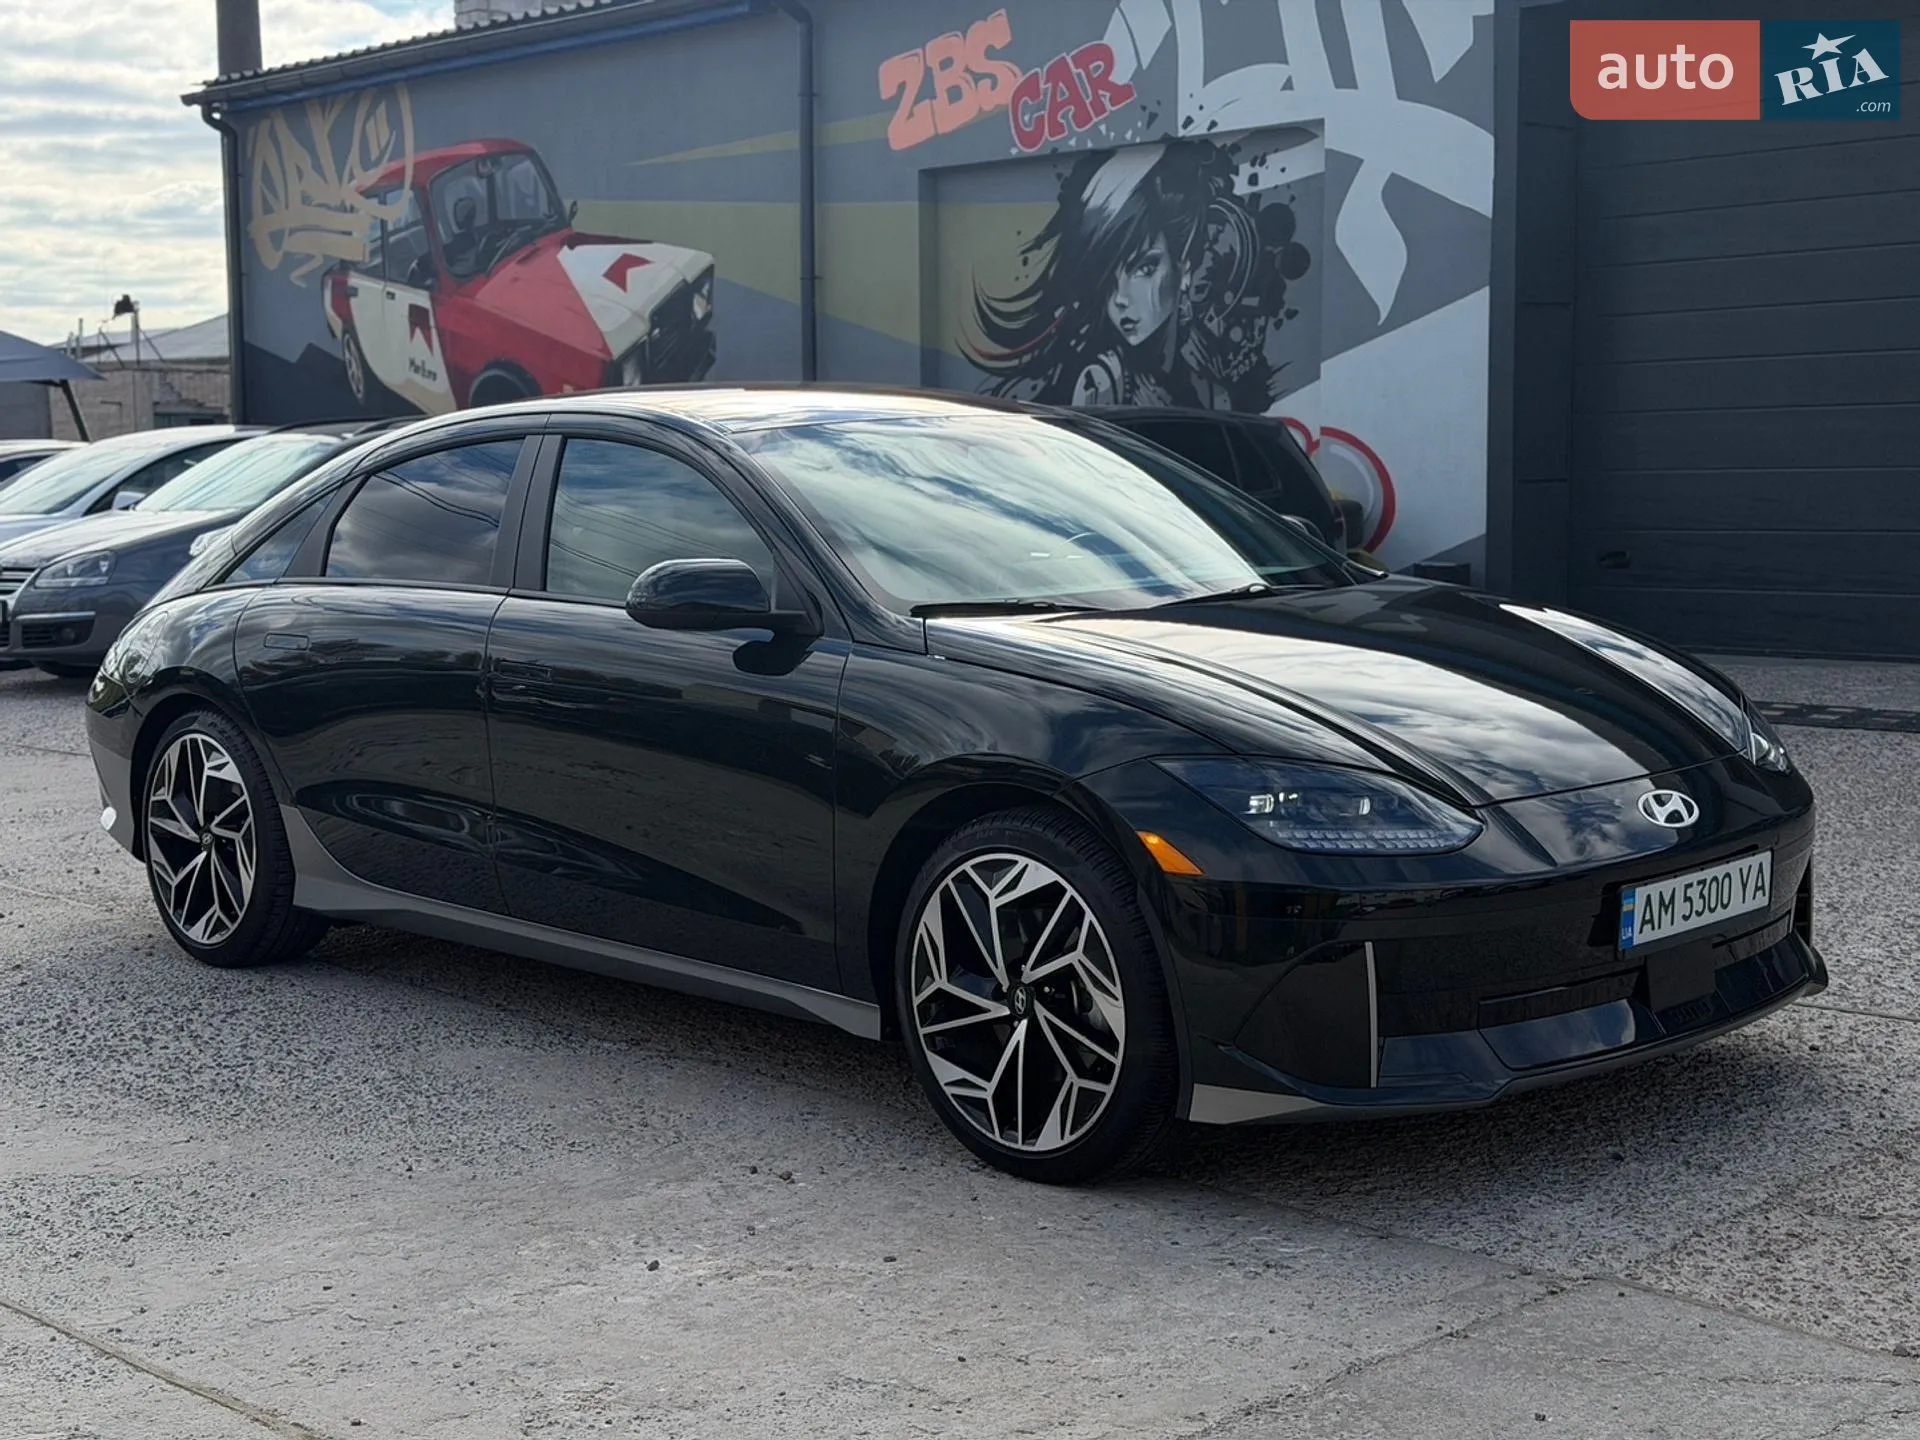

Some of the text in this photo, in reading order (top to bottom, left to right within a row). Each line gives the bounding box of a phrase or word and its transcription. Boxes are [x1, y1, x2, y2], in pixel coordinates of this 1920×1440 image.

[879, 8, 1022, 150] ZBS
[1009, 41, 1136, 152] CAR
[1638, 861, 1767, 935] AM 5300 YA
